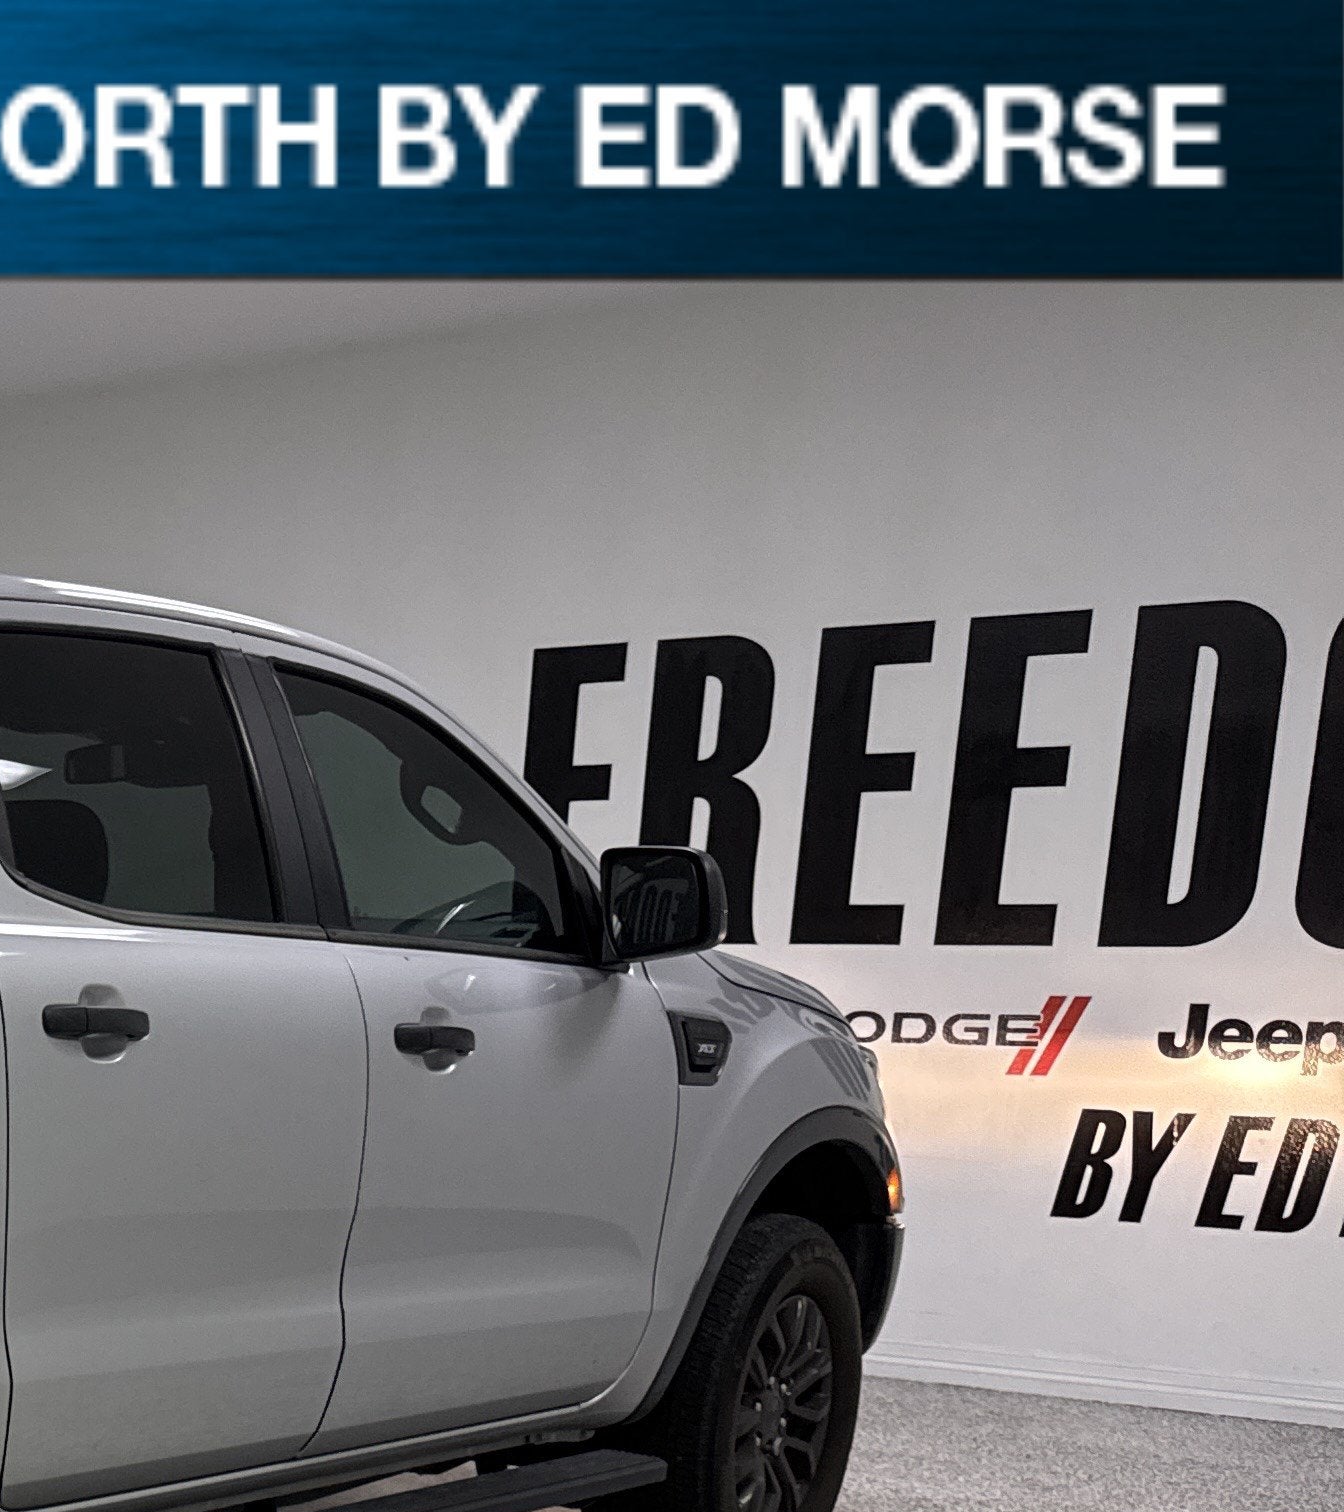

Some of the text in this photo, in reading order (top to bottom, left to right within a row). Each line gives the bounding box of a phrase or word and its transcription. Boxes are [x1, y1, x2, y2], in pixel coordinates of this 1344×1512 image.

[523, 600, 1344, 948] FREED
[845, 1009, 1043, 1048] ODGE
[1157, 1003, 1344, 1077] Jeep
[1049, 1107, 1342, 1234] BY ED
